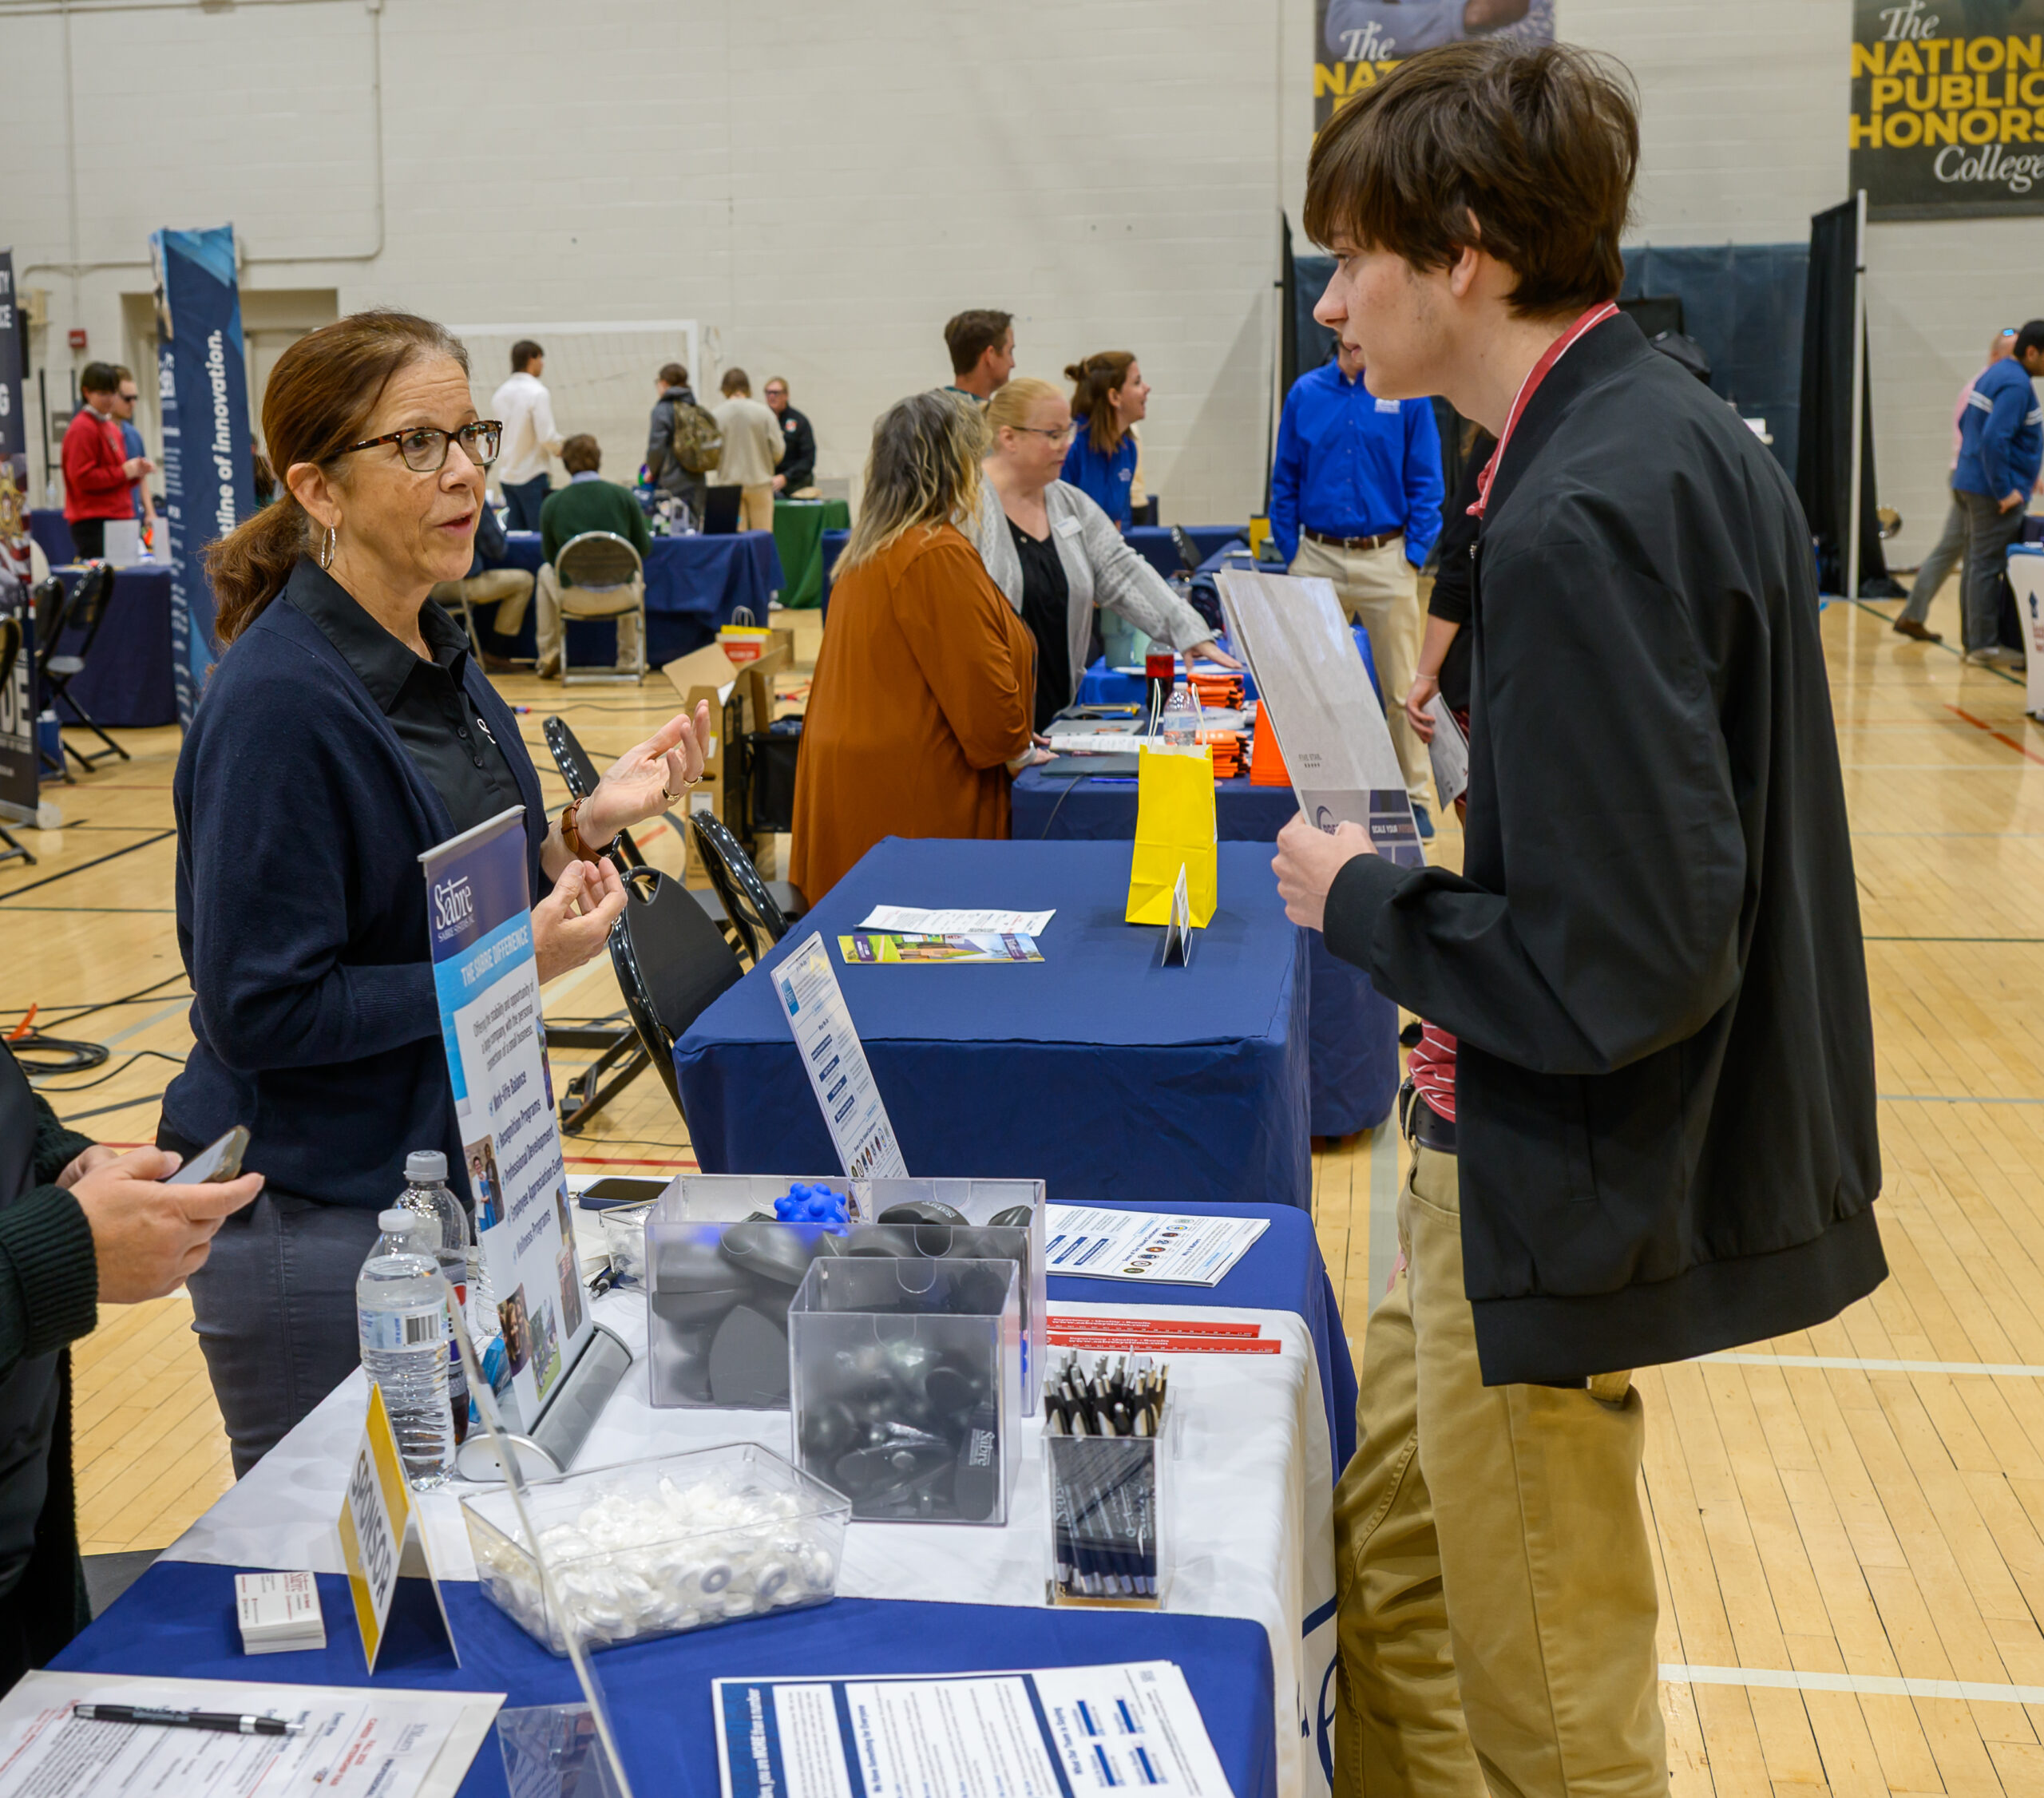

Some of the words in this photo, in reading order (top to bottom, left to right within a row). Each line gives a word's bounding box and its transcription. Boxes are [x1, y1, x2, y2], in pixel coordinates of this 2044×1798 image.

[1339, 20, 1396, 61] The
[1879, 0, 1939, 40] The
[1850, 34, 2044, 78] NATION
[1871, 69, 2044, 113] PUBLIC
[1848, 107, 2044, 150] HONORS
[1934, 142, 2044, 192] College
[205, 330, 232, 452] innovation.
[213, 454, 233, 481] of
[434, 875, 473, 929] Sabre
[461, 962, 476, 987] THE
[474, 948, 493, 979] SABRE
[492, 925, 529, 964] DIFFERENCE
[510, 984, 531, 1008] opportunity
[517, 1004, 533, 1024] personal
[509, 1071, 527, 1095] Balance
[499, 1117, 521, 1149] Recognition
[521, 1099, 541, 1123] Programs
[505, 1153, 528, 1186] Professional
[527, 1124, 554, 1159] Development
[510, 1192, 529, 1222] Employee
[528, 1167, 553, 1202] Appreciation
[532, 1210, 551, 1239] Programs
[978, 1431, 995, 1466] Sabre
[353, 1449, 391, 1609] SPONSOR
[745, 1687, 763, 1714] number
[750, 1735, 767, 1758] MORE
